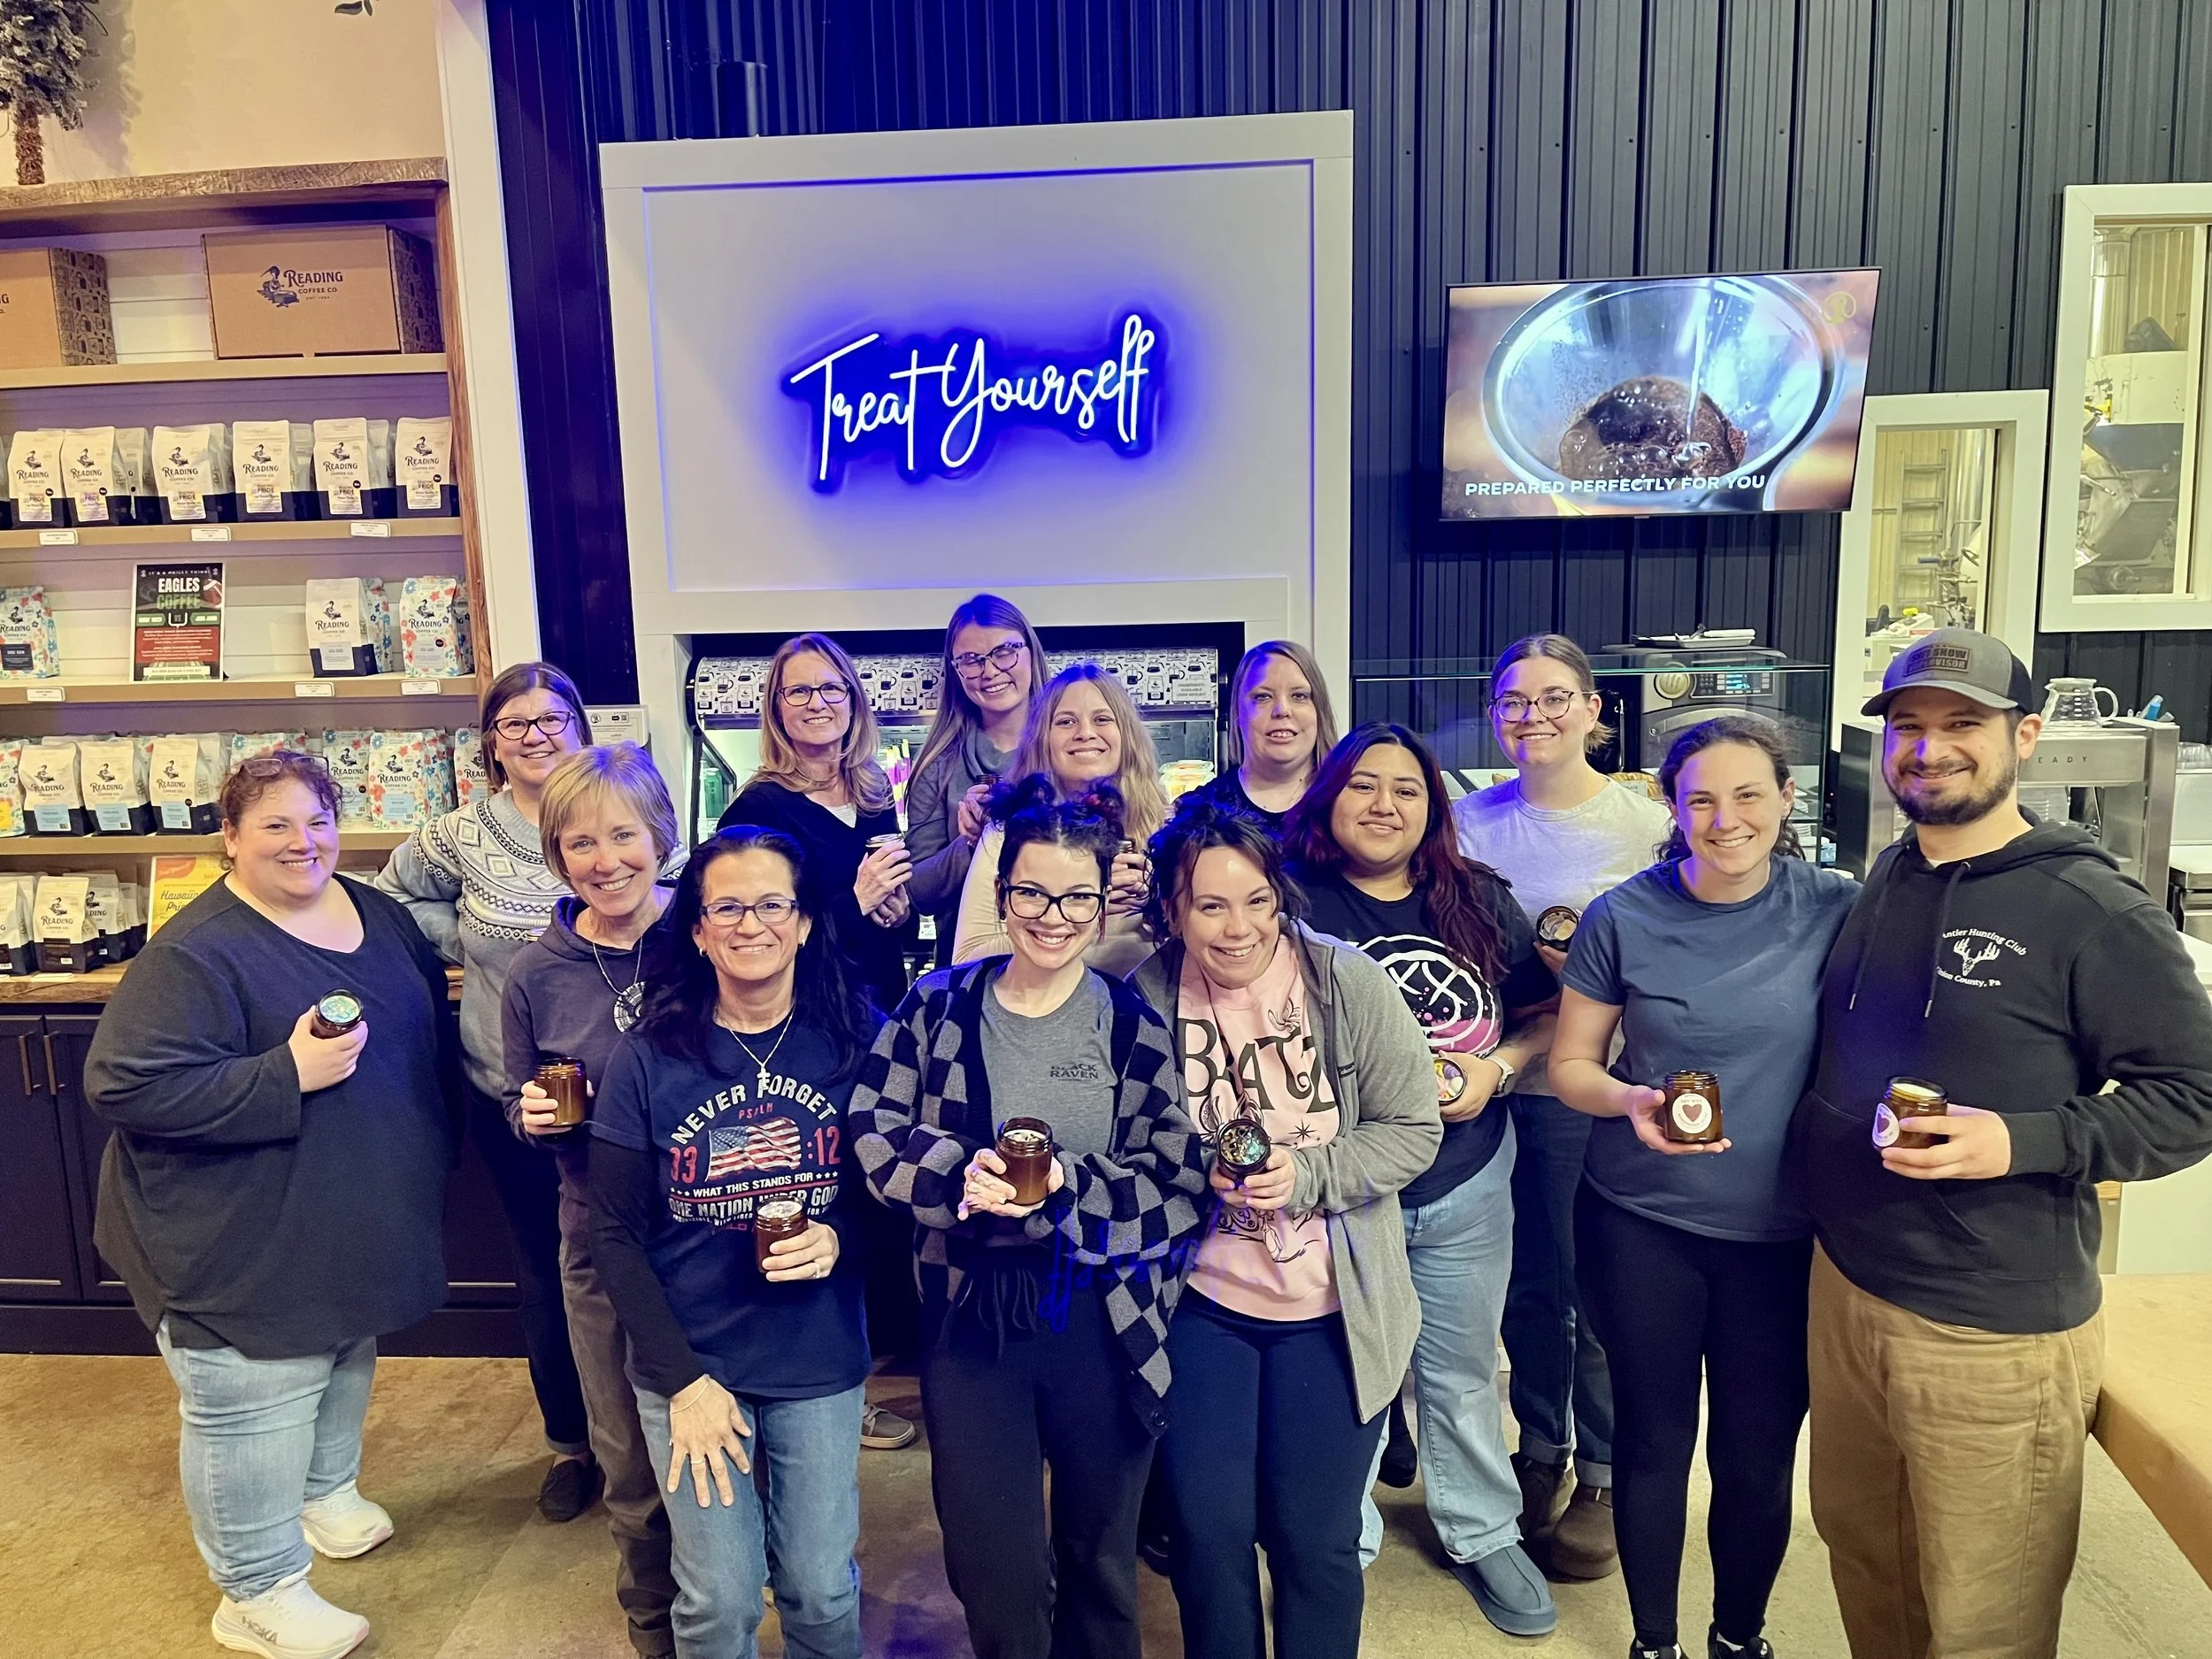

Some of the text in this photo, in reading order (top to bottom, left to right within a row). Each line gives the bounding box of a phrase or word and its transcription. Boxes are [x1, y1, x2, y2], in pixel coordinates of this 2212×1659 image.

[284, 270, 343, 287] READING
[790, 314, 1156, 481] Treat Yourself
[405, 456, 439, 466] READING
[162, 467, 198, 477] READING
[243, 463, 279, 474] READING
[323, 462, 358, 472] READING
[16, 469, 49, 480] READING
[70, 468, 102, 478] READING
[1464, 475, 1764, 495] PREPARED PERFECTLY FOR YOU
[158, 578, 200, 593] EAGLES
[157, 594, 201, 610] COFFEE
[0, 625, 31, 633] READING
[315, 620, 349, 631] READING
[409, 618, 442, 629] READING
[1932, 648, 1966, 659] SHOW
[331, 767, 364, 776] READING
[464, 768, 486, 779] READ
[157, 779, 185, 789] READING
[377, 774, 411, 783] READING
[31, 783, 64, 792] RADING
[90, 783, 123, 793] READING
[41, 916, 73, 925] READING
[1968, 928, 2006, 945] Hunting
[2005, 939, 2027, 956] Club
[1050, 1070, 1098, 1079] RAVEN
[671, 1075, 837, 1145] NEVER FORGET
[693, 1172, 813, 1198] WHAT THIS STANDS FOR
[668, 1198, 693, 1217] ONE
[697, 1197, 753, 1219] NATION
[811, 1185, 839, 1207] GOD
[242, 1615, 278, 1646] HOKA
